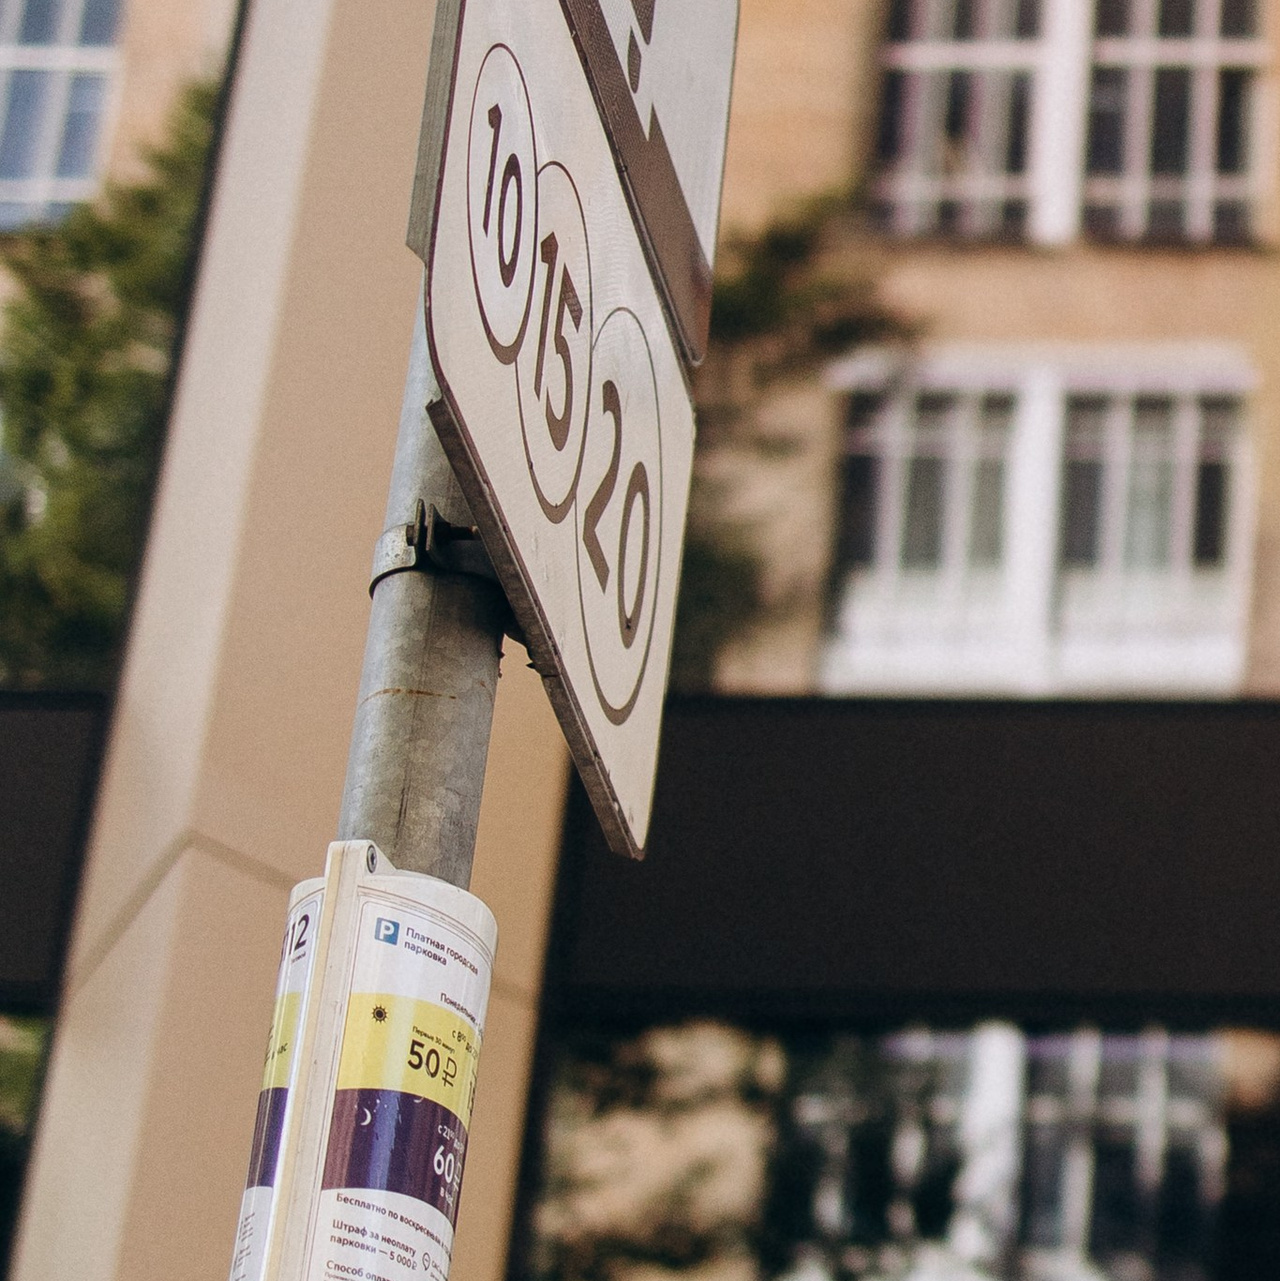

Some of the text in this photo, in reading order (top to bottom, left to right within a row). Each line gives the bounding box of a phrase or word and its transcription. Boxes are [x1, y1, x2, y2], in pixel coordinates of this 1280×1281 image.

[483, 103, 523, 288] 10
[533, 231, 584, 452] 15
[582, 379, 650, 650] 20
[404, 941, 447, 966] парковка
[406, 926, 479, 975] Платная городская
[336, 1192, 387, 1216] Бесплатно
[388, 1209, 399, 1220] по
[330, 1235, 377, 1254] парковки
[332, 1219, 417, 1258] Штраф за неоплату
[326, 1259, 364, 1278] Способ
